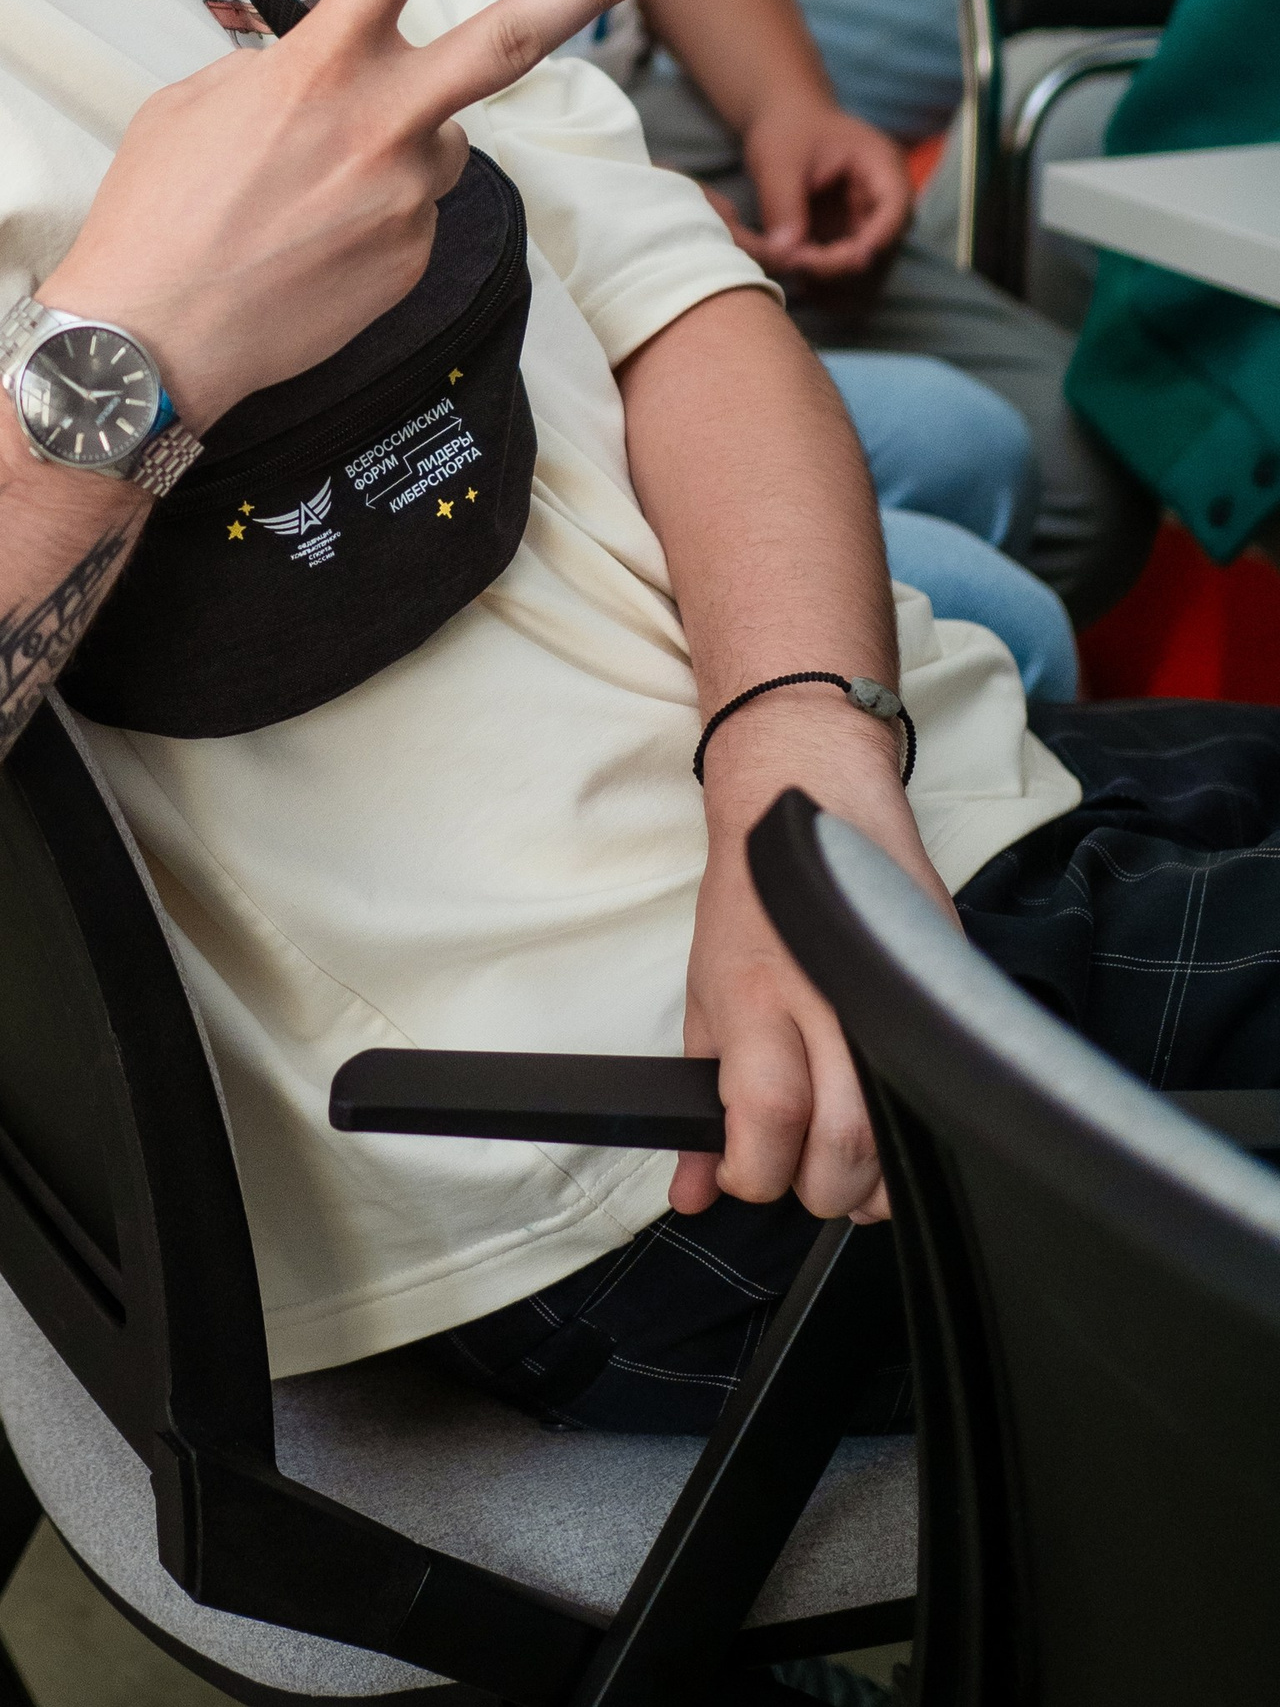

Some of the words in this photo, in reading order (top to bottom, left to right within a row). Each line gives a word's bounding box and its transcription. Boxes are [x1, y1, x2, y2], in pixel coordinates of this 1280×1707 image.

[344, 397, 455, 479] ВСЕРОССИЙСКИЙ
[416, 431, 474, 476] ЛИДЕРЫ
[354, 454, 399, 490] ФОРУМ
[389, 446, 482, 513] КИБЕРСПОРТА
[308, 545, 332, 560] СПОРТА
[309, 550, 335, 568] РОССИИ
